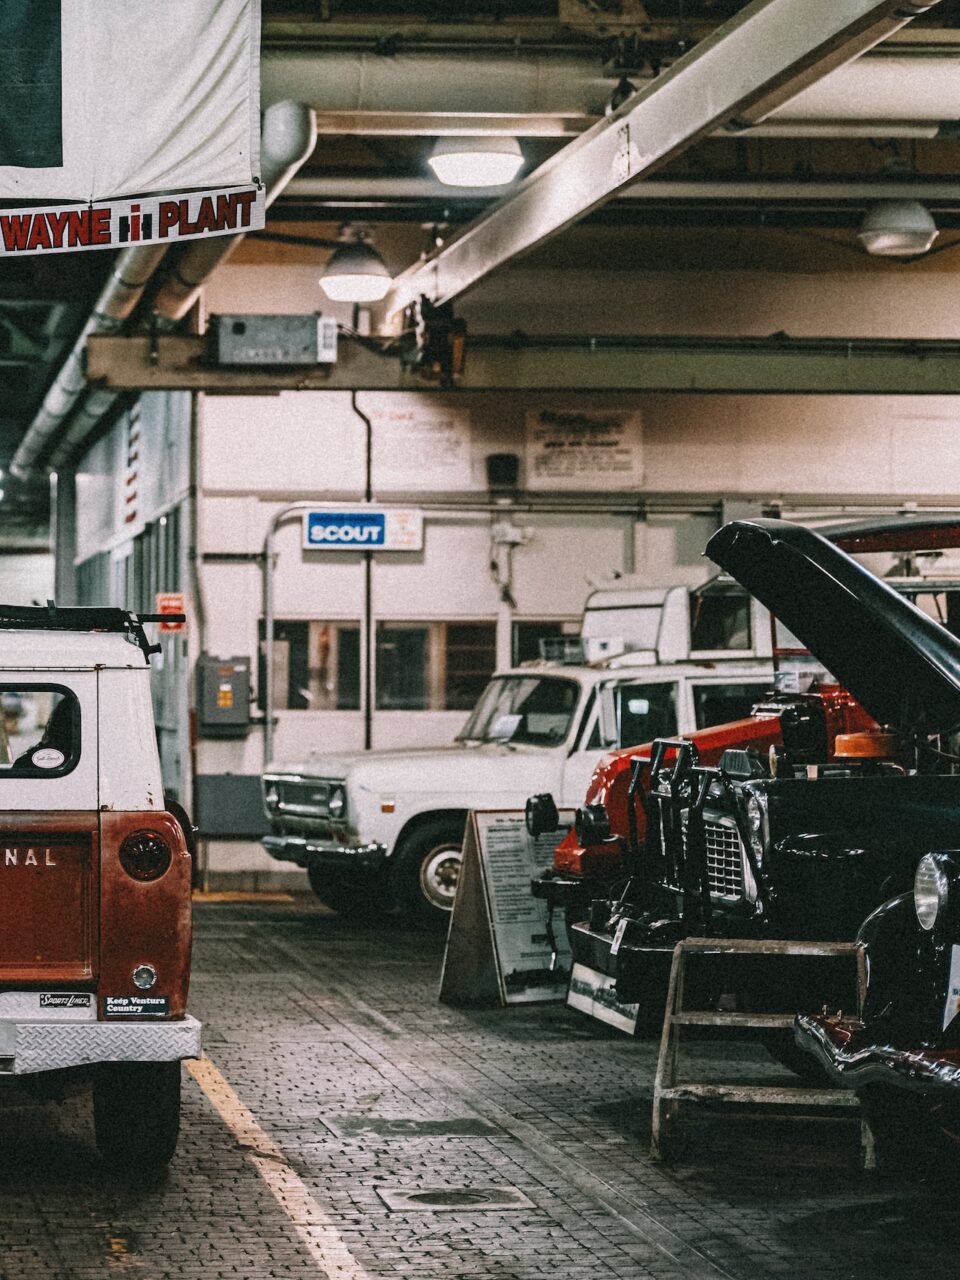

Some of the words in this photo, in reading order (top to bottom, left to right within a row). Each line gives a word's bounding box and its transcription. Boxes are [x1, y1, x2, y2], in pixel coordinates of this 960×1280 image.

[158, 189, 257, 238] PLANT
[310, 525, 382, 542] SCOUT
[106, 997, 129, 1006] Keep
[131, 997, 166, 1005] Ventura
[106, 1005, 143, 1013] Country
